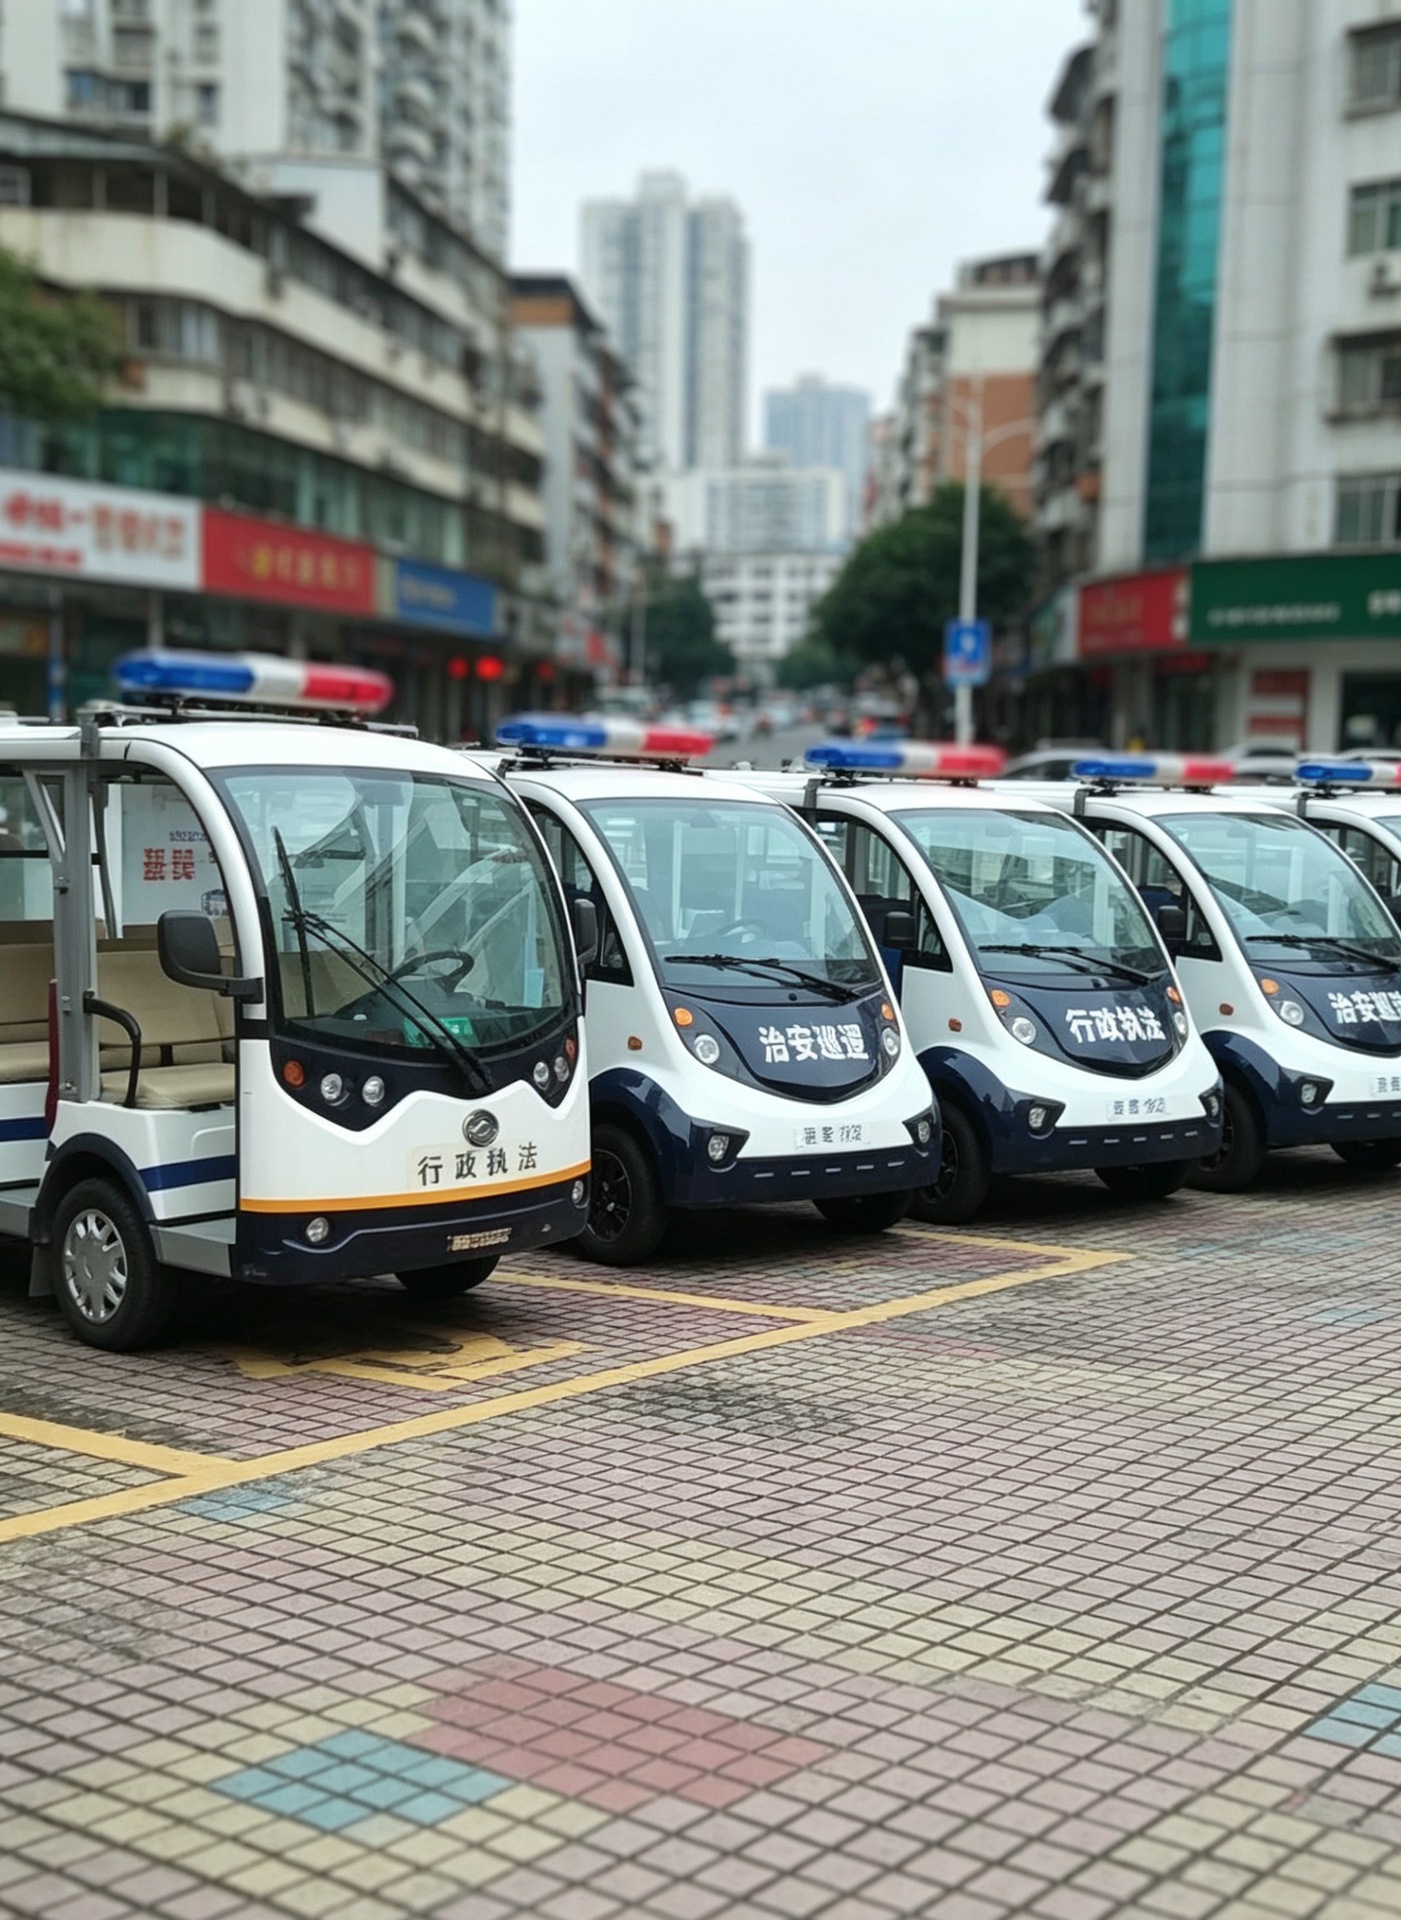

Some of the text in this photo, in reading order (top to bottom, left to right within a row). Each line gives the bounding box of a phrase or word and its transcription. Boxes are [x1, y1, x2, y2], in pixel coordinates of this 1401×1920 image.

[1065, 1006, 1166, 1043] 行政执法
[417, 1141, 539, 1187] 行政执法
